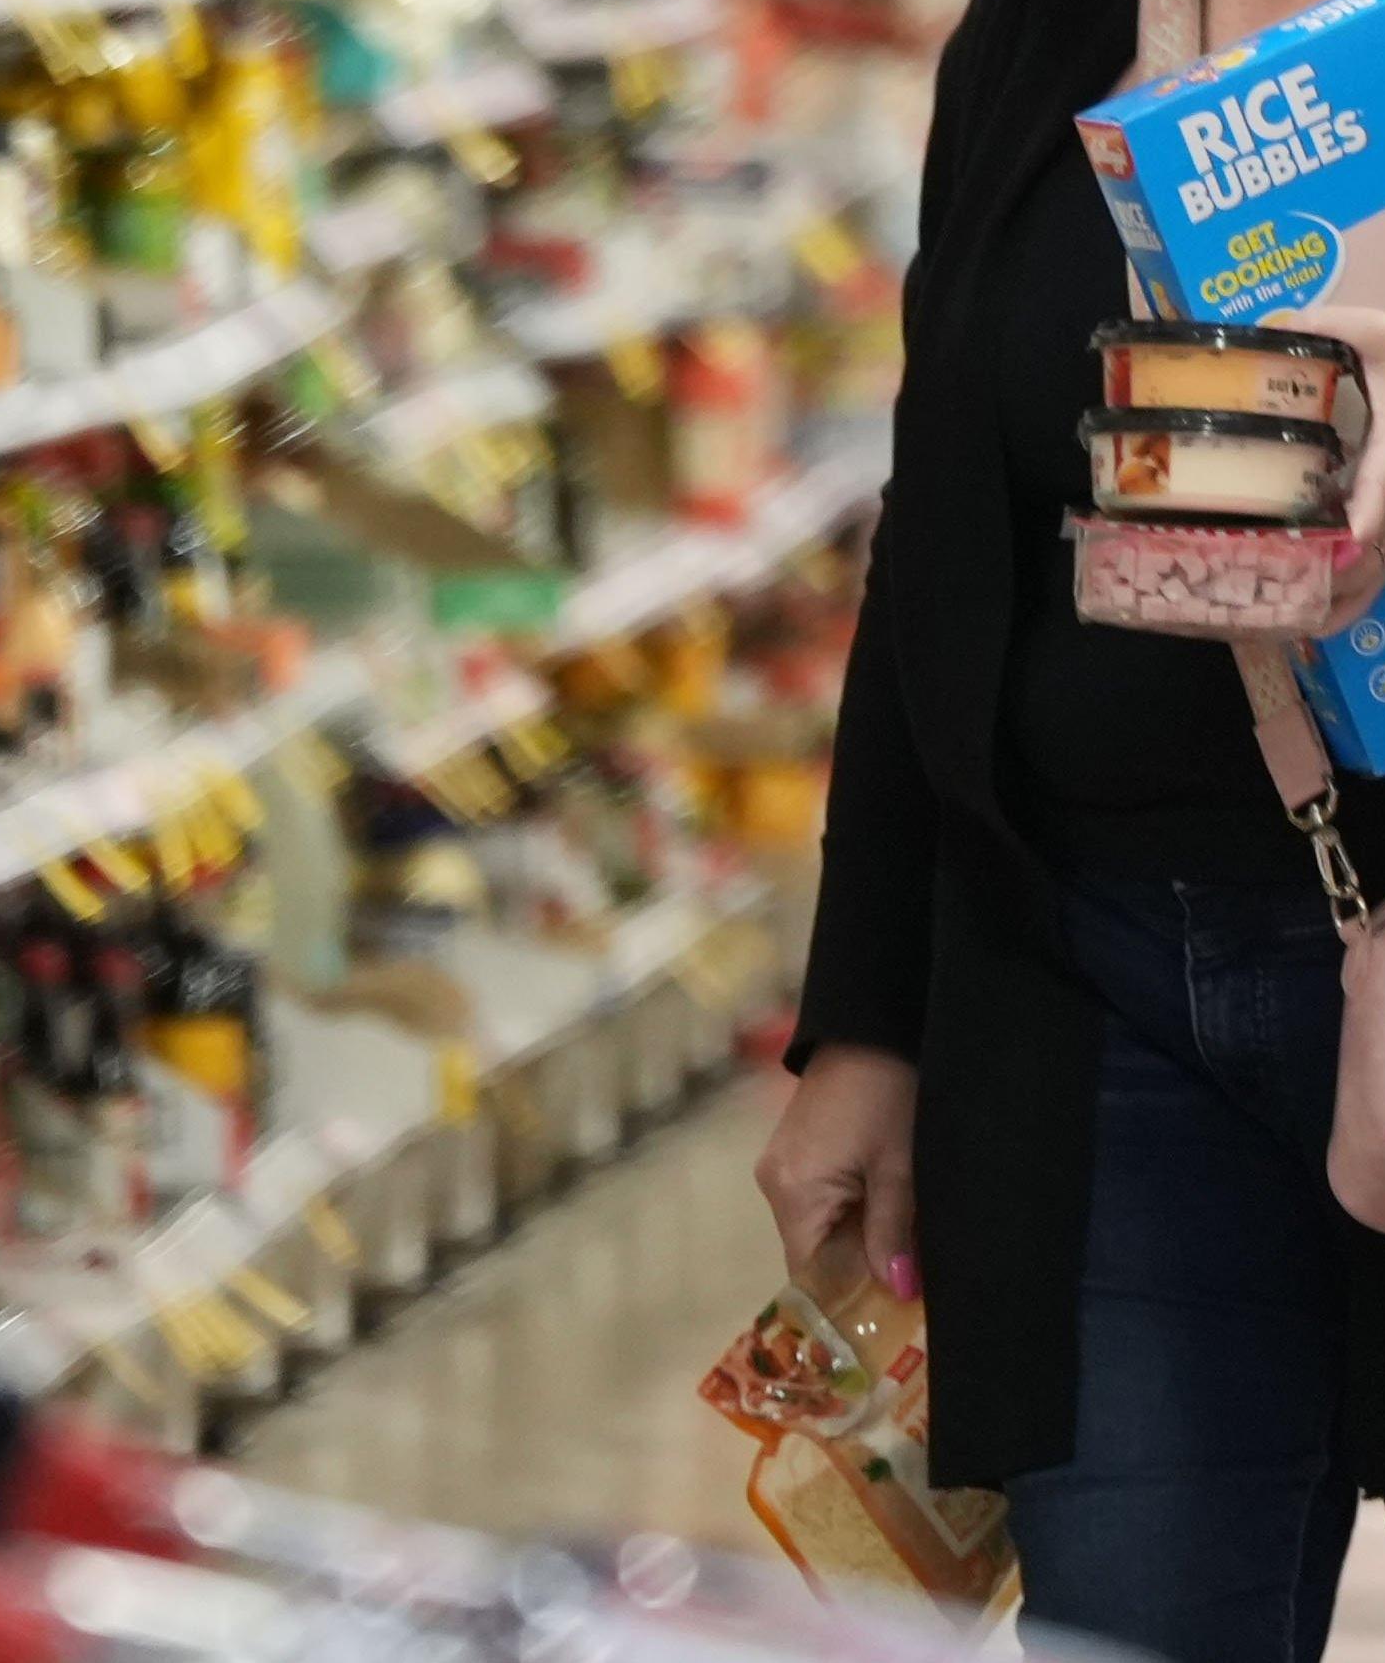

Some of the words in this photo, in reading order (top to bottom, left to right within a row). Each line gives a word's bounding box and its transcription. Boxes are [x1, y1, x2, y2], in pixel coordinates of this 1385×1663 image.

[1177, 63, 1331, 176] RICE
[1177, 110, 1367, 225] BUBBLES
[1200, 231, 1328, 304] COOKING
[1227, 220, 1279, 260] GET
[1218, 290, 1255, 319] with
[1254, 279, 1283, 303] the
